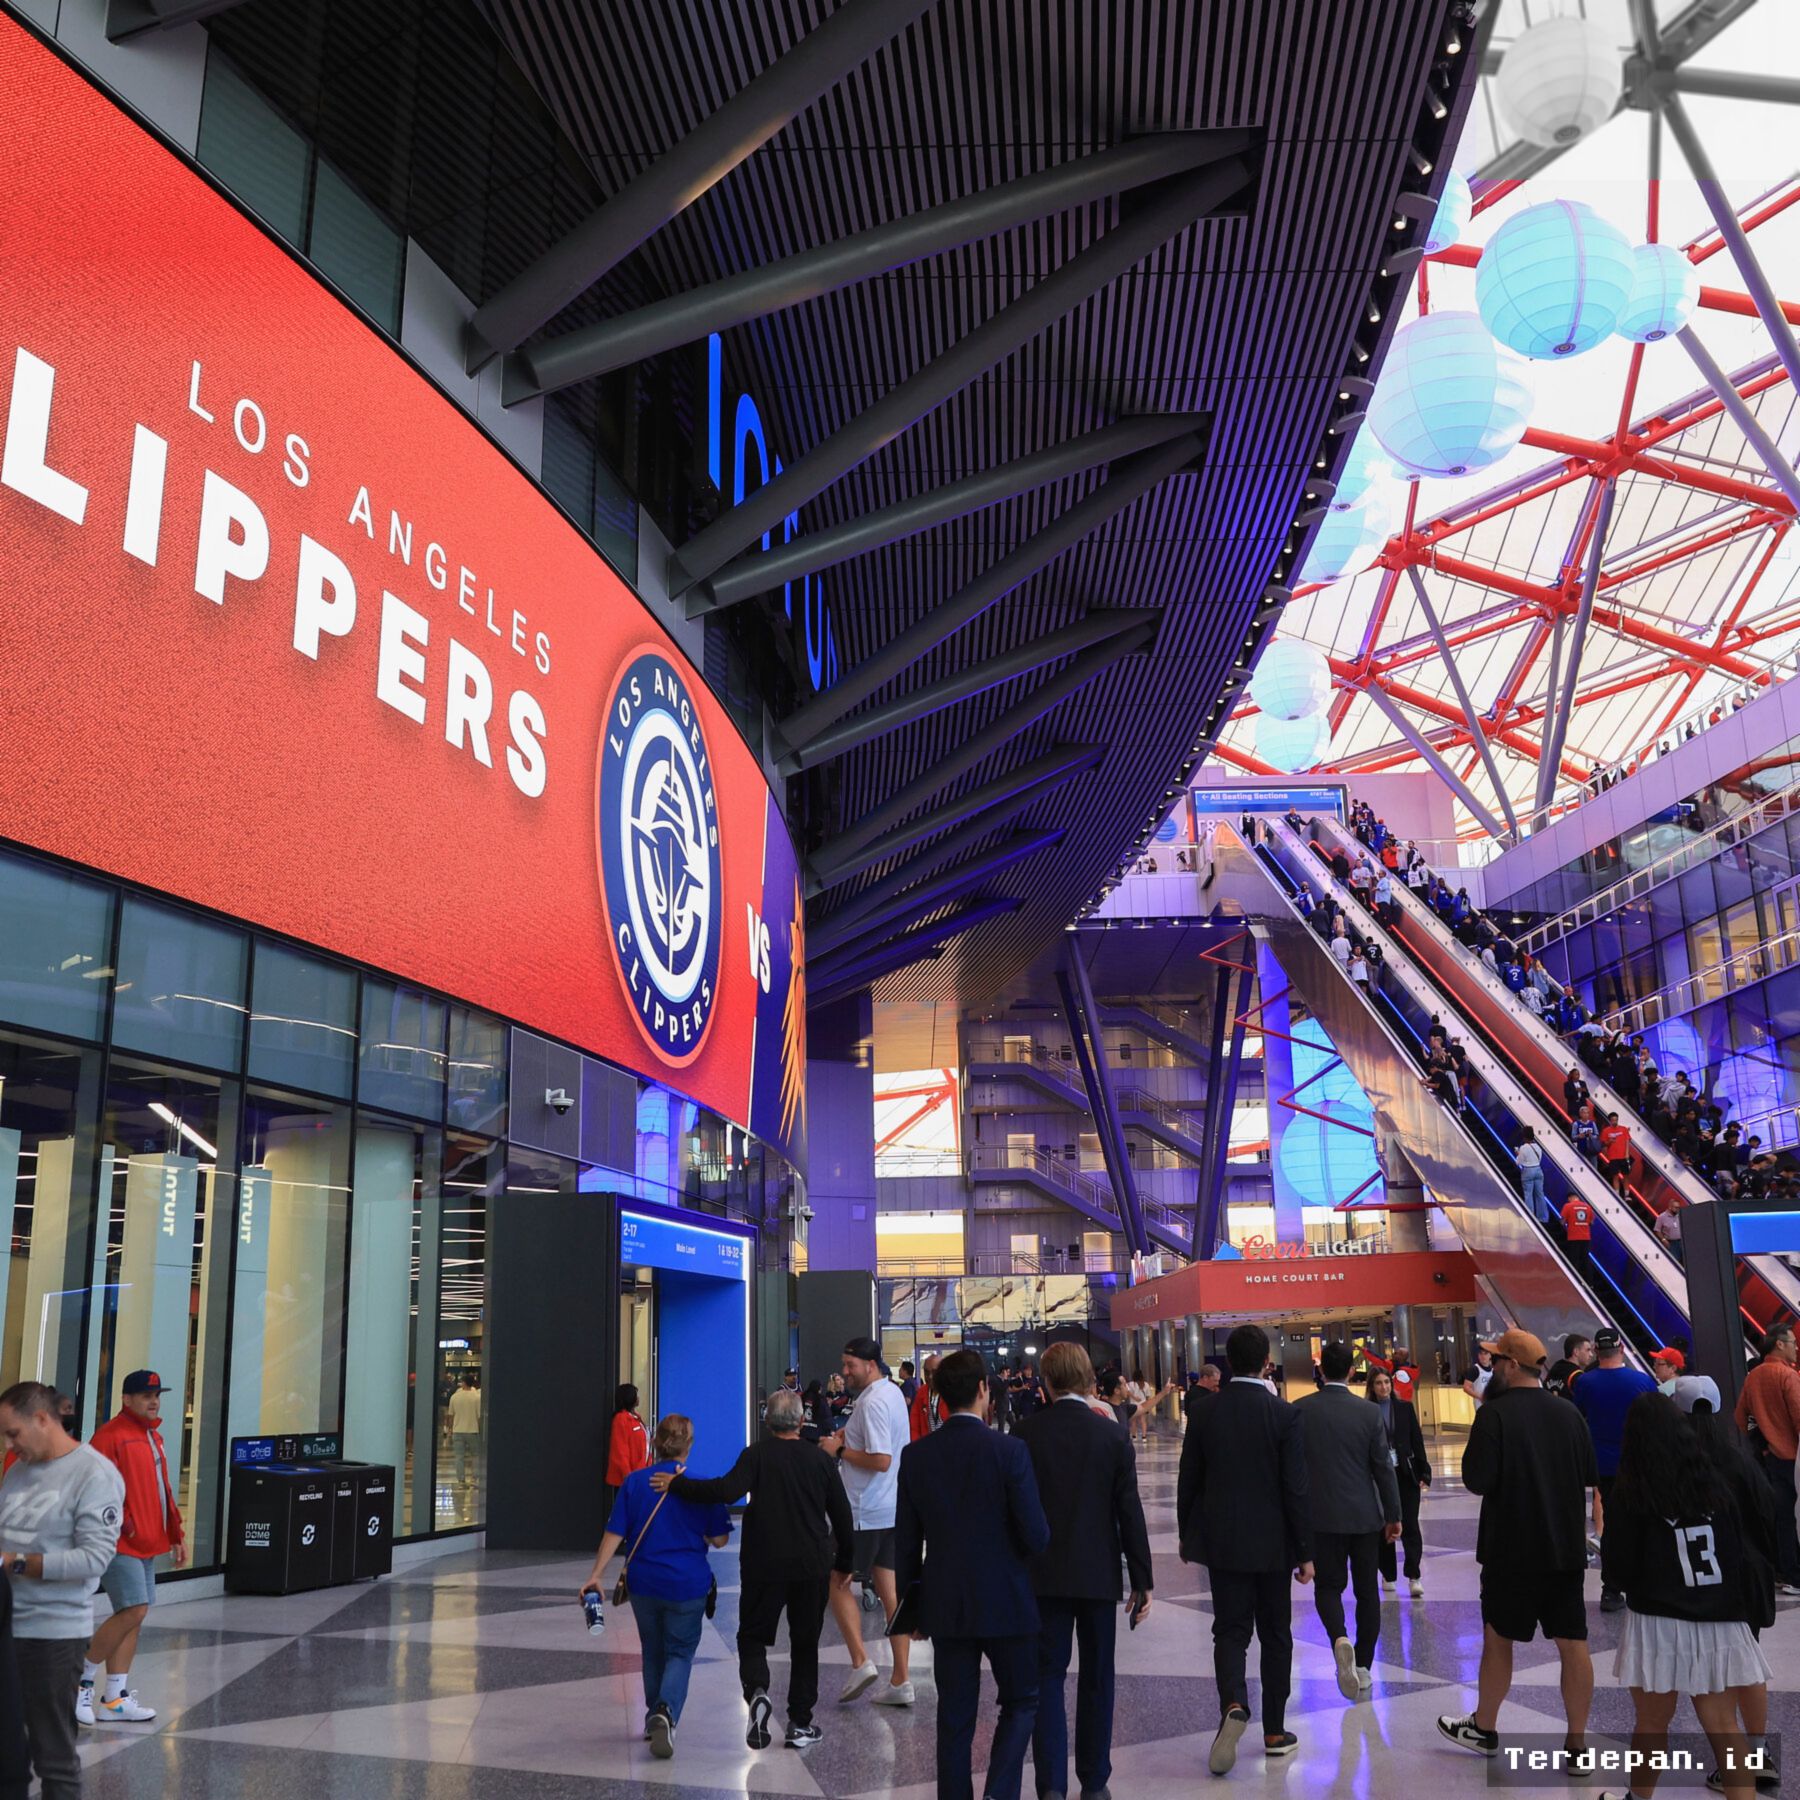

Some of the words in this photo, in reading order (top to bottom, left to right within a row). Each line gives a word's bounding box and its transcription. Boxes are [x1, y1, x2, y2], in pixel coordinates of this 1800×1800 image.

[188, 359, 311, 488] LOS
[347, 485, 551, 675] ANGELES
[609, 676, 642, 758] LOS
[654, 668, 718, 848] ANGELES
[1253, 792, 1288, 800] Sections
[747, 902, 771, 994] VS
[618, 922, 711, 1043] CLIPPERS
[623, 1222, 638, 1238] 2-17
[1241, 1234, 1310, 1260] Coors
[1313, 1238, 1375, 1257] LIGHT
[1246, 1275, 1278, 1284] HOME
[1282, 1273, 1319, 1282] COURT
[1323, 1272, 1345, 1281] BAR
[299, 1492, 323, 1501] RECYCLING
[1674, 1524, 1723, 1587] 13
